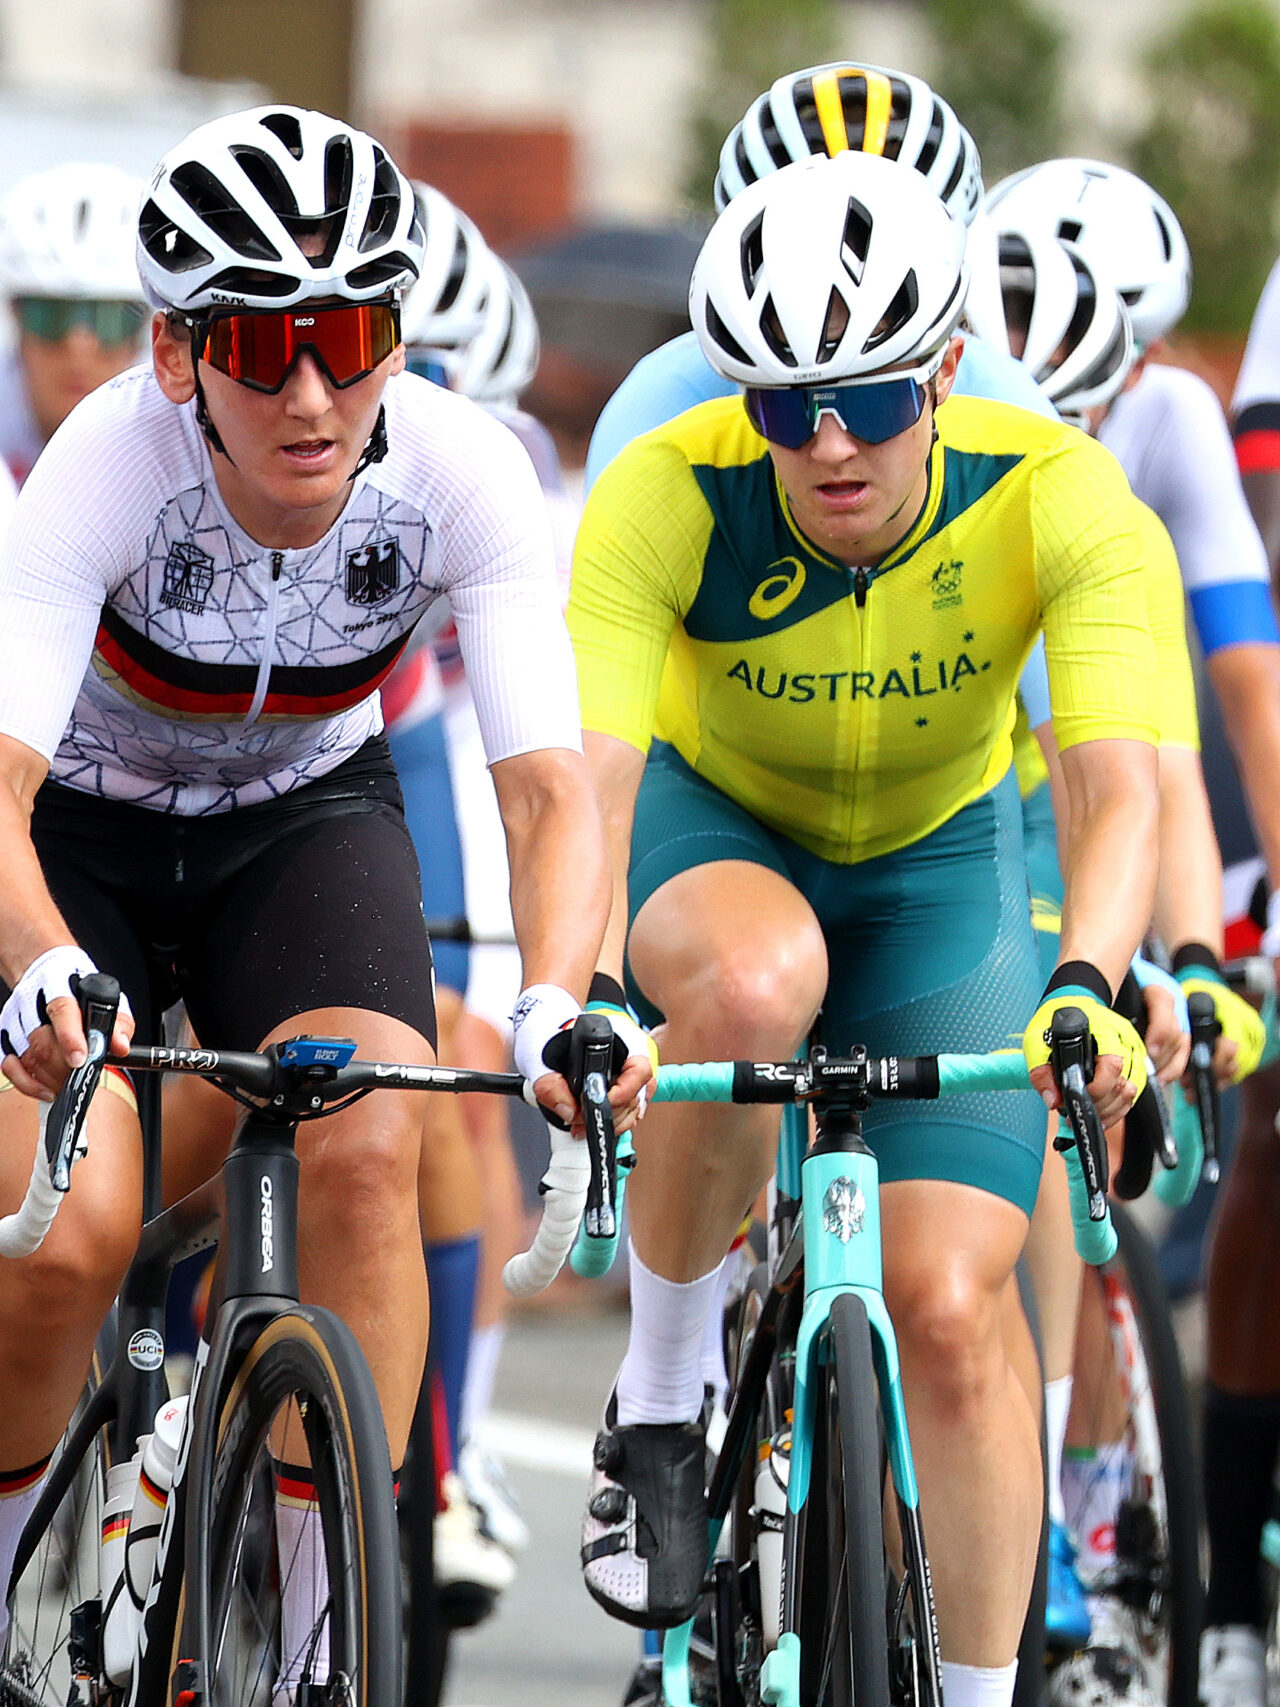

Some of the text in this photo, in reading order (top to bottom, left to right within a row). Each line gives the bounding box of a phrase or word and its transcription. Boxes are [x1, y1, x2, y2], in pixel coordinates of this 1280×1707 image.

[343, 620, 374, 634] Tokyo
[727, 652, 978, 703] AUSTRALIA
[821, 1066, 859, 1076] GARMIN
[261, 1175, 274, 1273] ORBEA
[138, 1345, 157, 1354] UCI
